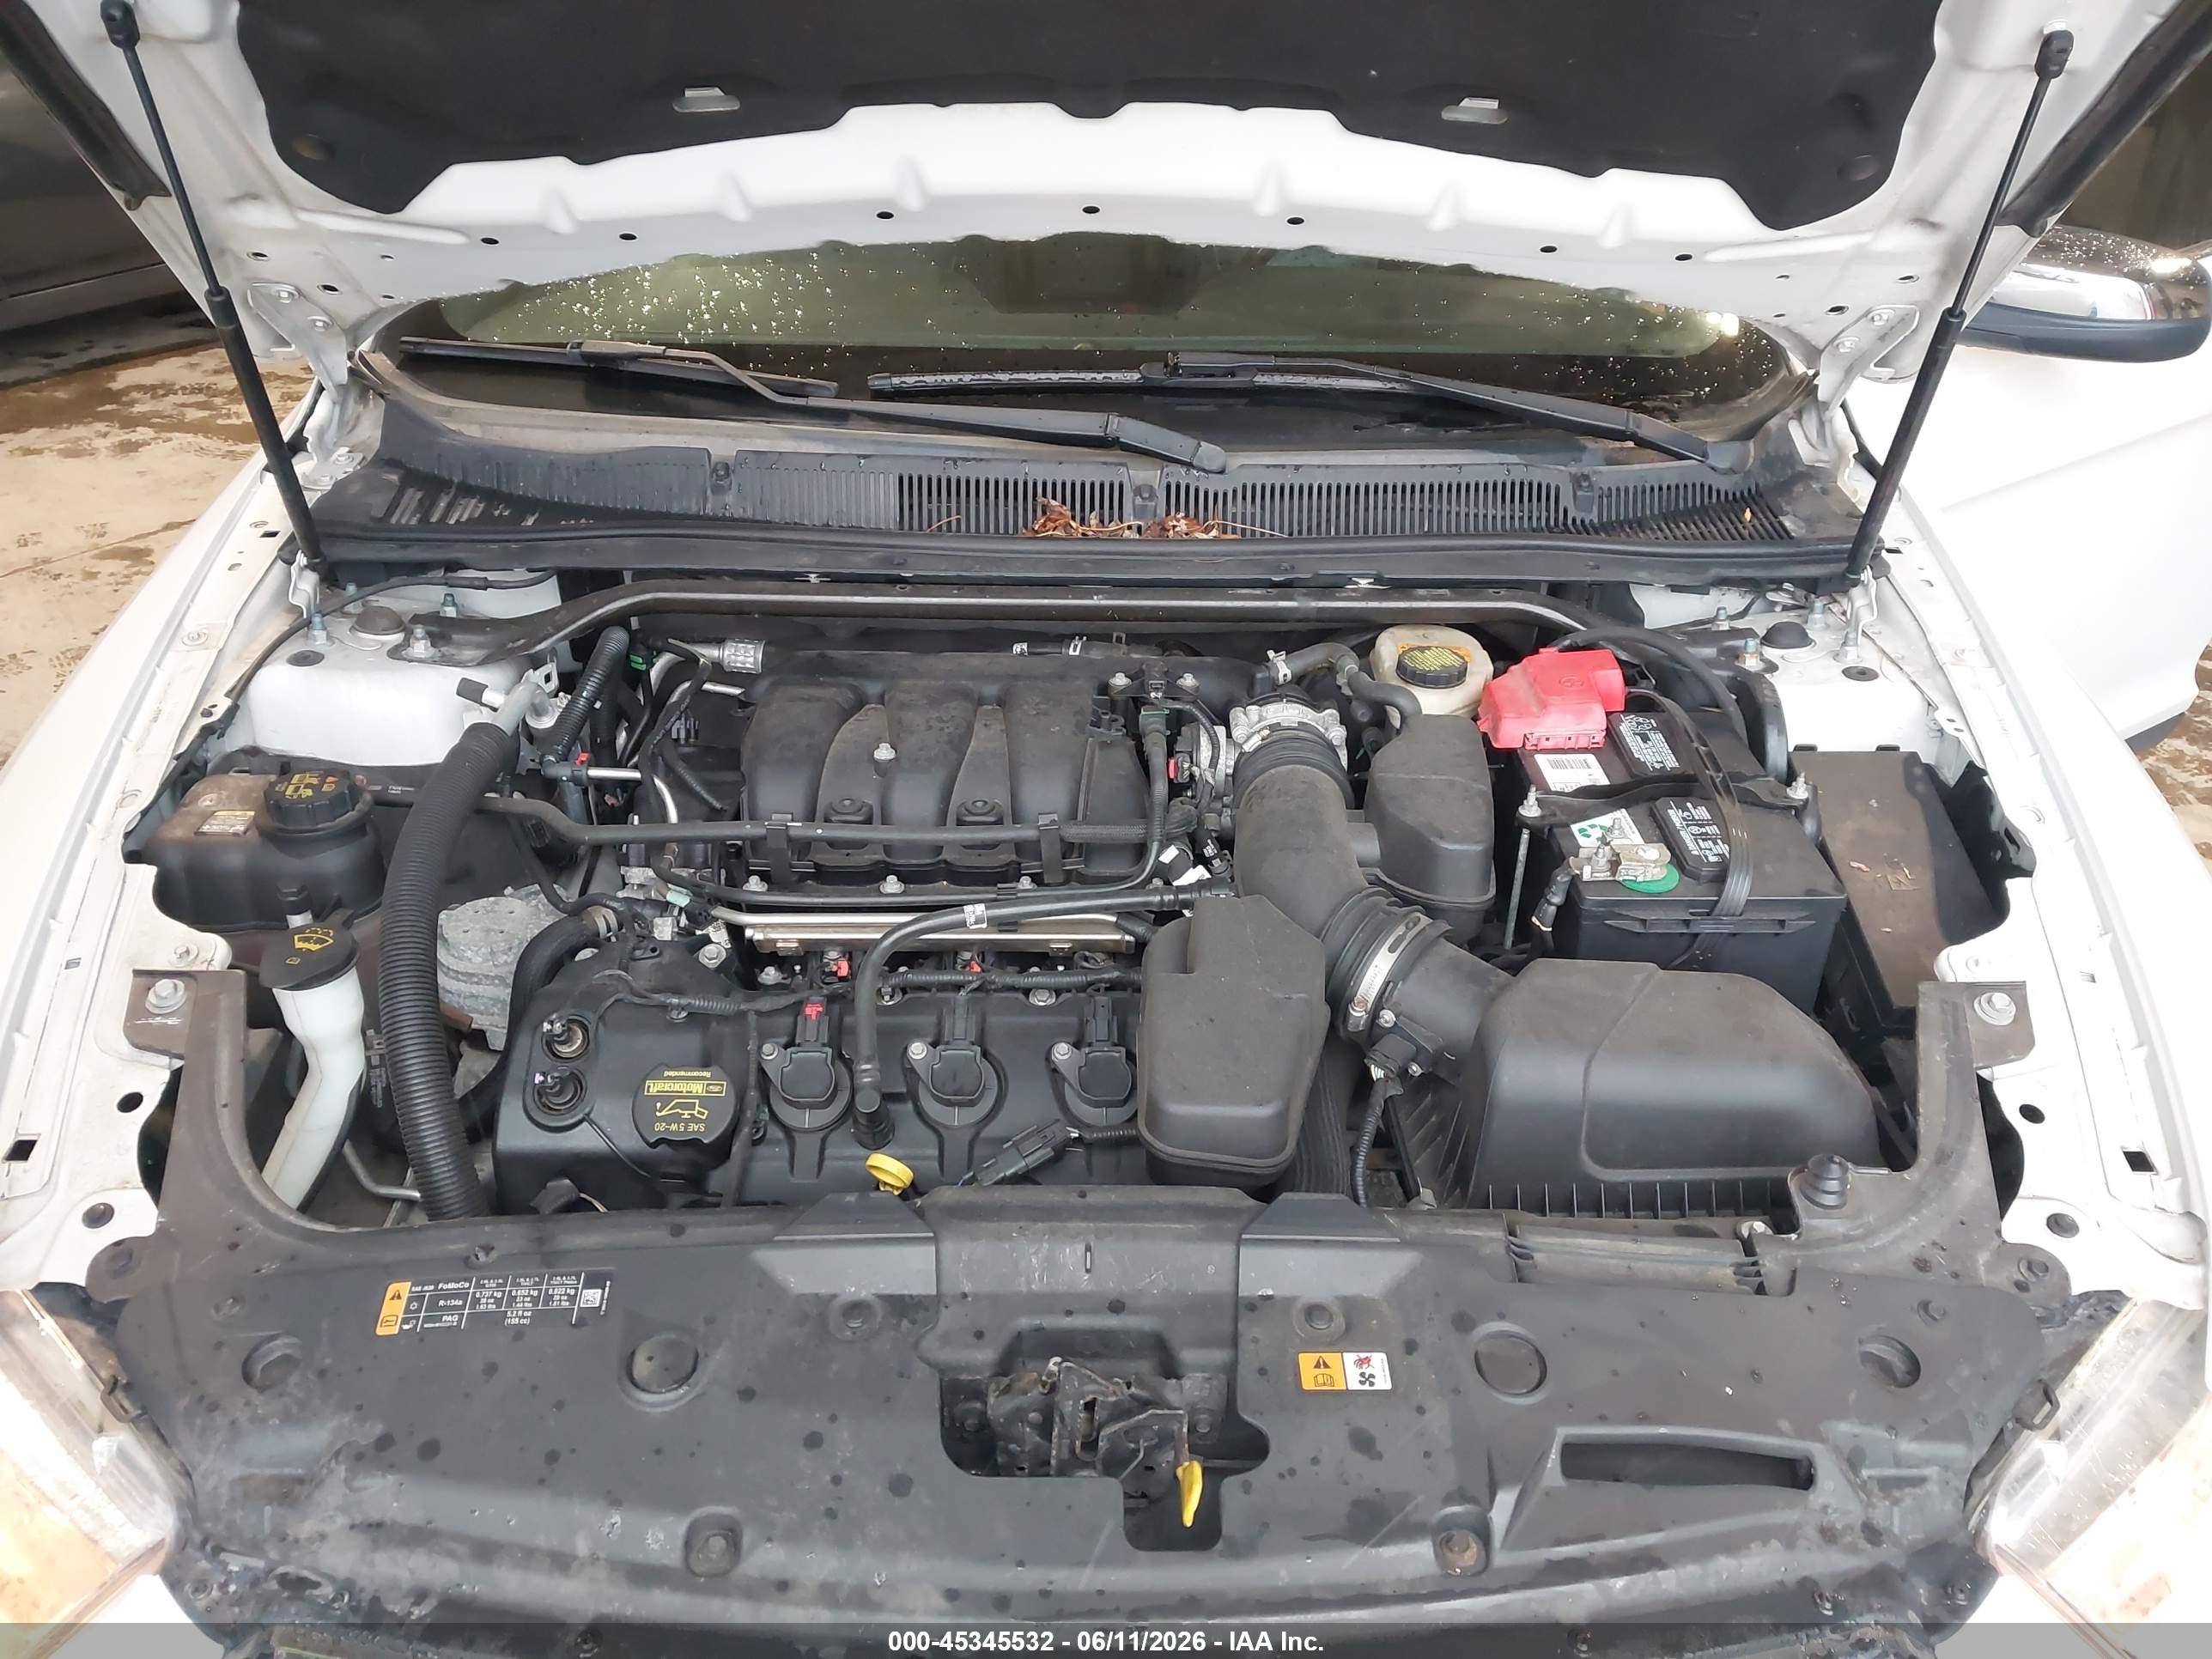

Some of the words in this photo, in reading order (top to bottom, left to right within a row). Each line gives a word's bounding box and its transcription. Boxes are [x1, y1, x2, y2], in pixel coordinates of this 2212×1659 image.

[648, 1082, 703, 1094] Motorcraft
[654, 1122, 685, 1132] 5W-20
[687, 1123, 705, 1131] SAE
[438, 1282, 470, 1290] FoMoCo
[438, 1299, 463, 1307] R-134a
[504, 1318, 520, 1326] (155
[520, 1317, 530, 1325] cc)
